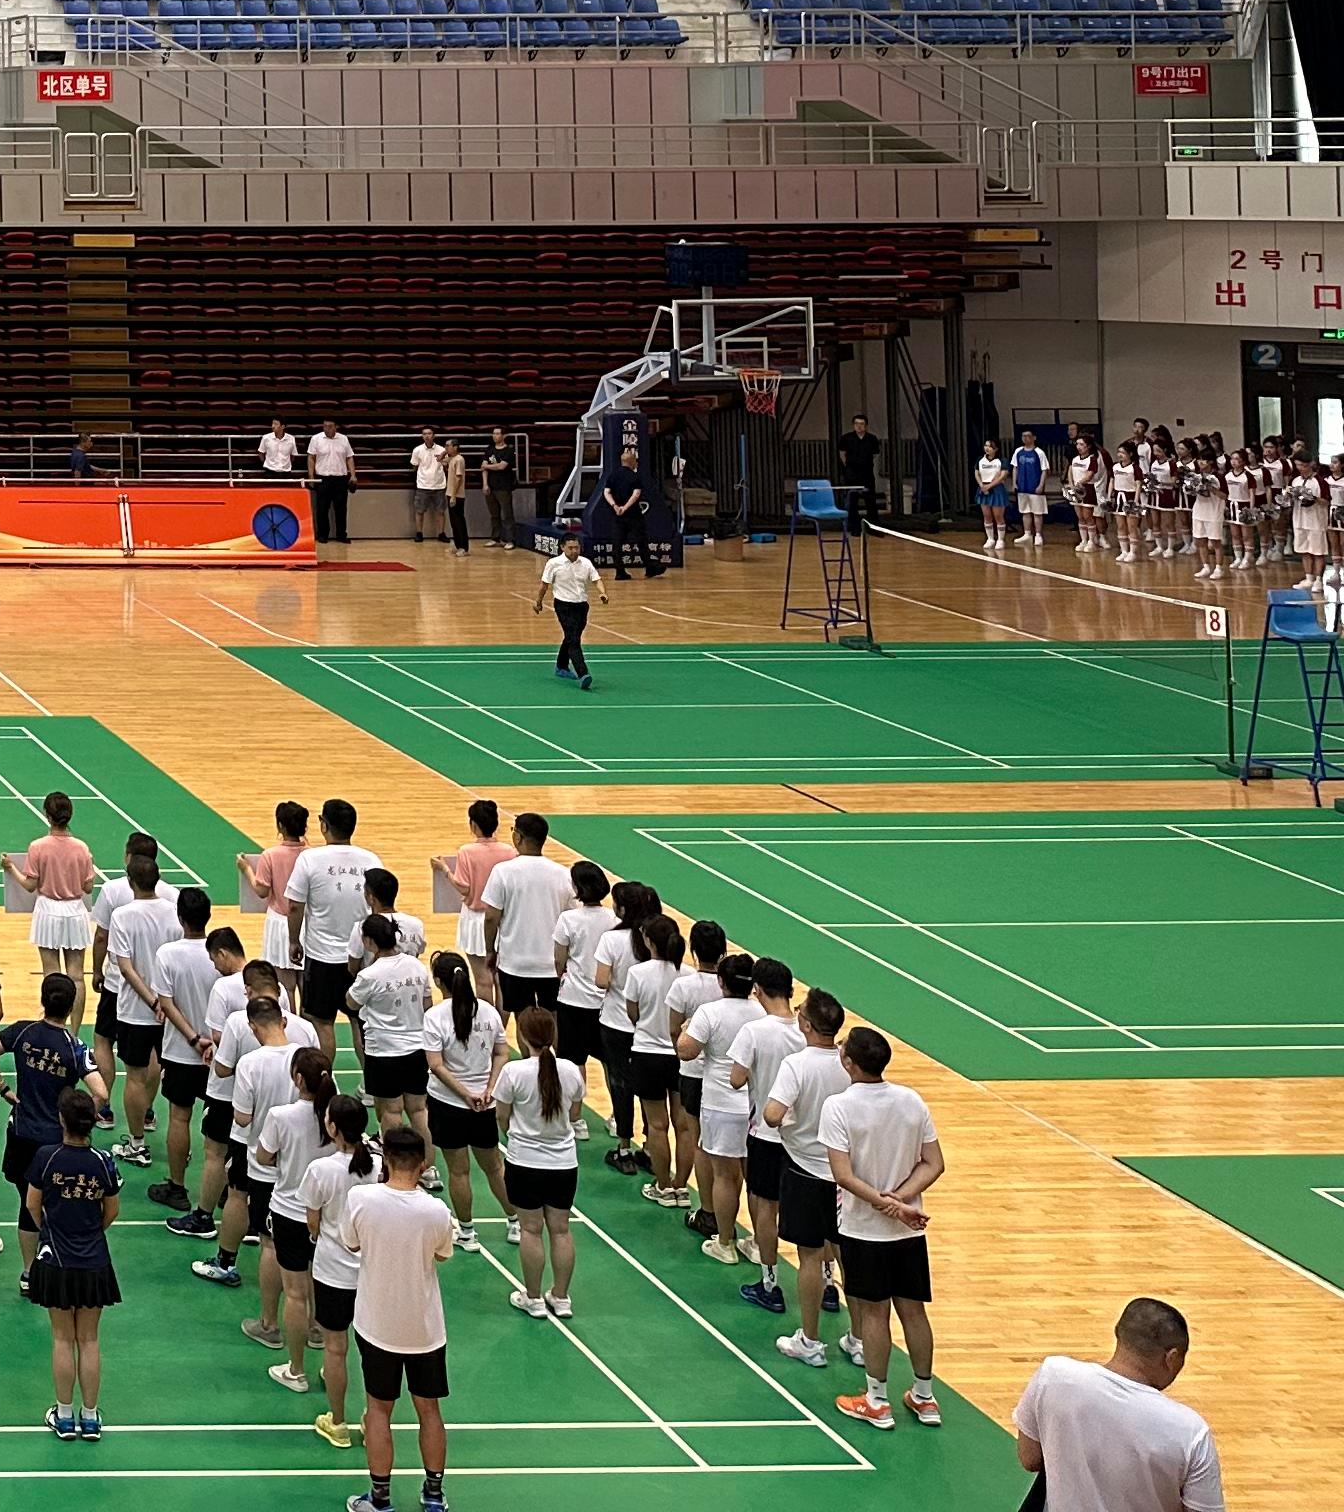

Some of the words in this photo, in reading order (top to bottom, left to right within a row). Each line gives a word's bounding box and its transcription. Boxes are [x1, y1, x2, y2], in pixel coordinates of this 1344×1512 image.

[1141, 67, 1201, 78] 9号门出口
[43, 75, 107, 97] 北区单号
[1230, 250, 1323, 273] 2号门
[1216, 280, 1342, 310] 出口
[1258, 344, 1277, 365] 2
[1209, 609, 1221, 632] 8
